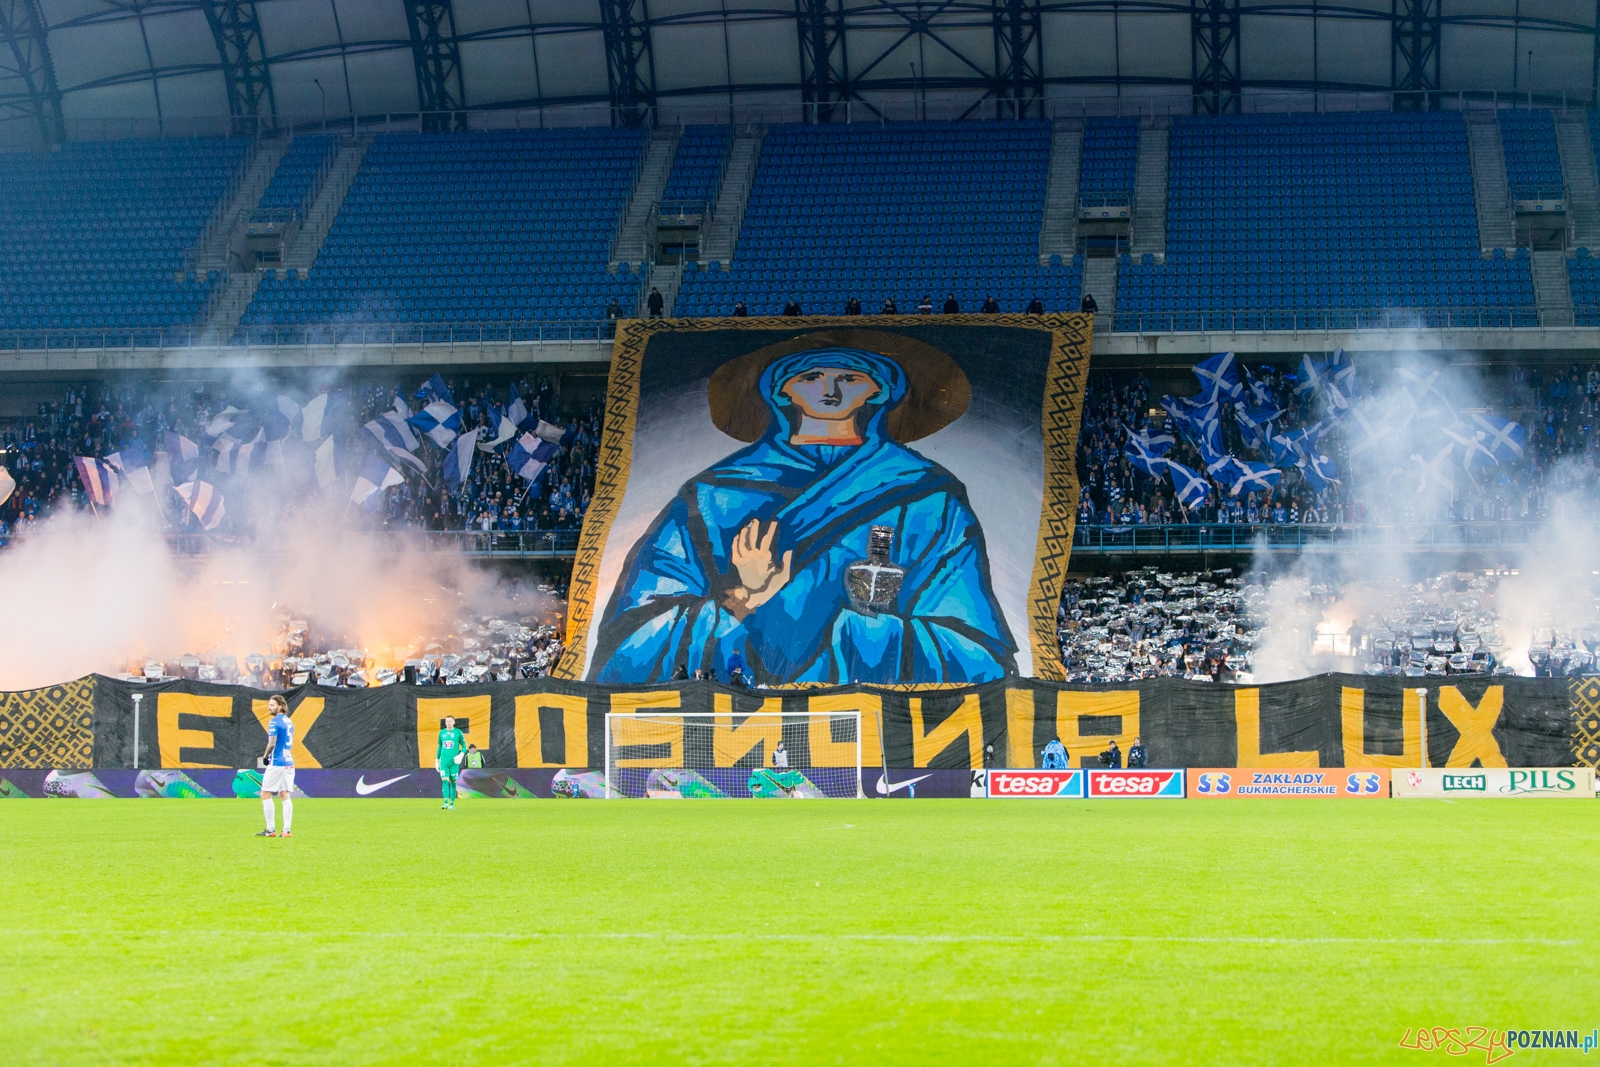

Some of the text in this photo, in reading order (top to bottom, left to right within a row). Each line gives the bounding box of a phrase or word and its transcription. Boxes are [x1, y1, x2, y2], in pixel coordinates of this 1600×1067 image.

[157, 692, 325, 769] EX
[1235, 685, 1508, 769] LUX
[994, 774, 1055, 793] tesa
[1095, 774, 1156, 793] tesa
[1197, 772, 1232, 795] STS
[1252, 773, 1325, 784] ZAKŁADY
[1345, 772, 1381, 795] STS
[1445, 776, 1484, 789] LECH
[1508, 769, 1576, 793] PILS
[1237, 785, 1337, 795] BUKMACHERSKIE
